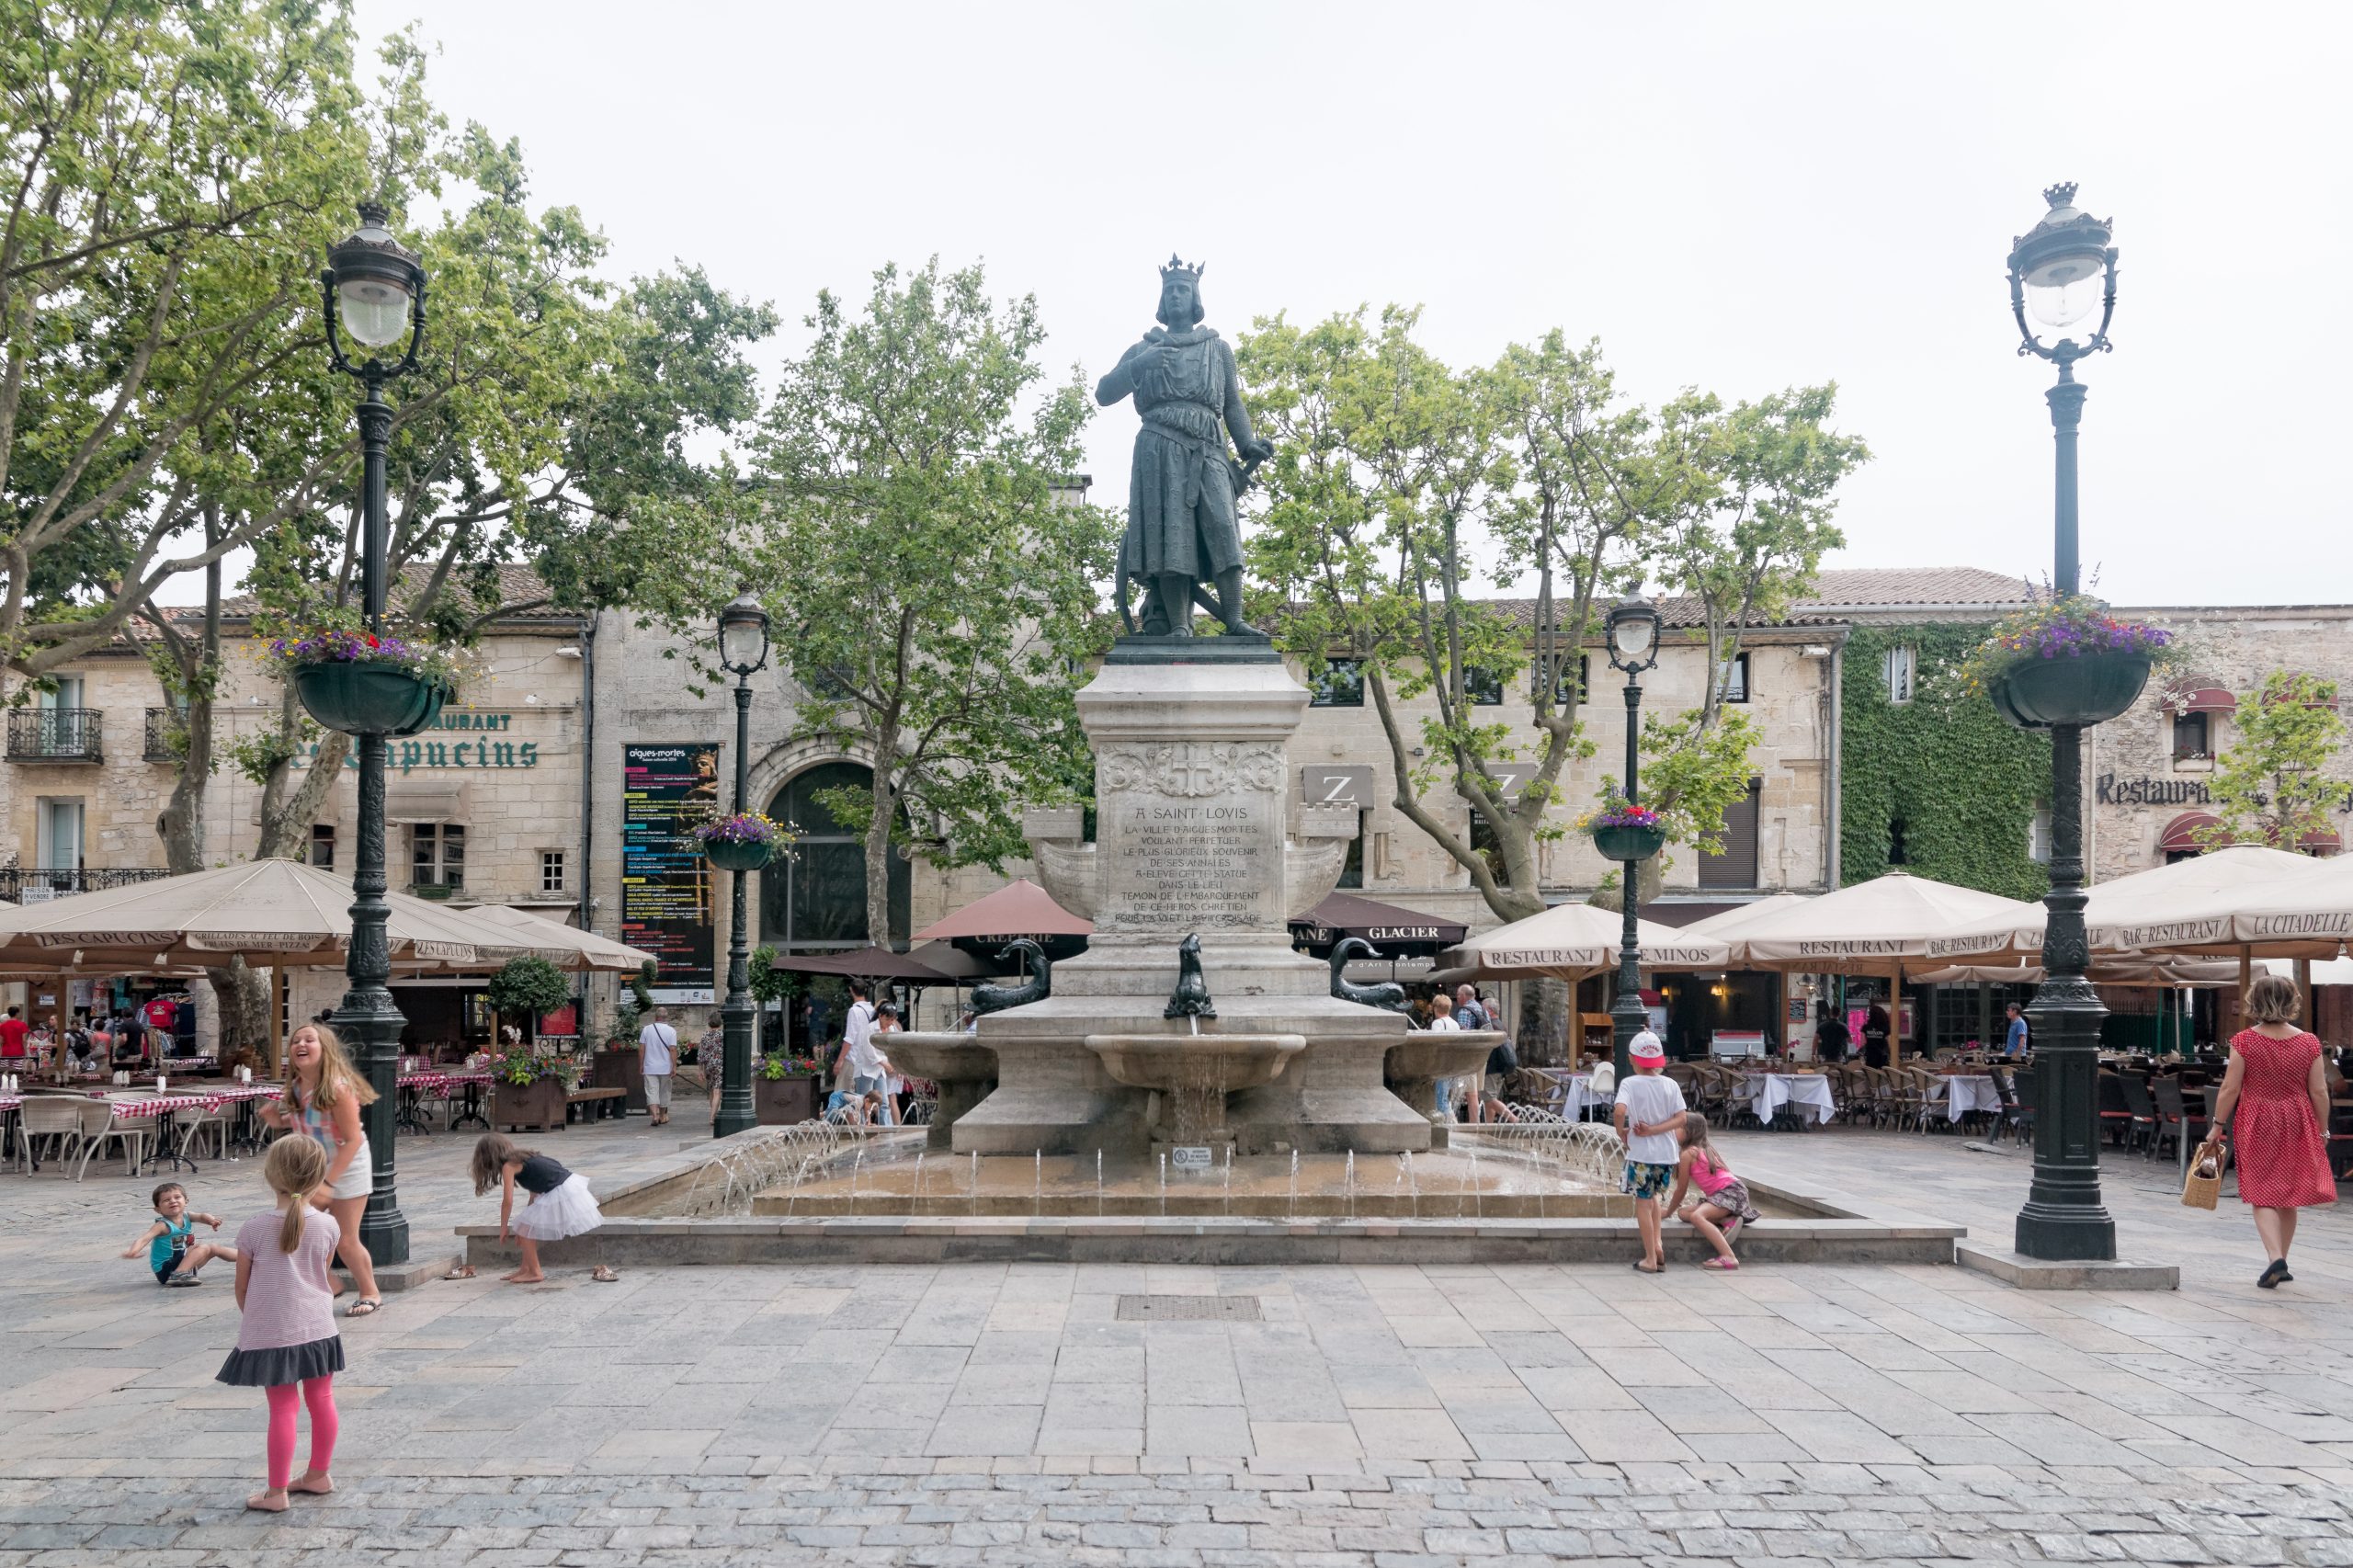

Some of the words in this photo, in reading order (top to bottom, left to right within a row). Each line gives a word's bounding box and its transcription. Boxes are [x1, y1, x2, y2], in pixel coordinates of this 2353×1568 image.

[429, 714, 512, 731] AURANT
[1323, 776, 1355, 801] Z
[1135, 807, 1145, 819] A
[1154, 807, 1198, 819] SAINT
[1206, 807, 1247, 820] LOVIS
[1125, 825, 1137, 835] LA
[1143, 825, 1169, 834] VILLE
[1141, 836, 1185, 845] VOULANT
[1123, 848, 1134, 857] LE
[1138, 848, 1160, 857] PLUS
[1164, 847, 1209, 857] GLORIEUX
[1212, 847, 1258, 857] SOUVENIR
[1150, 858, 1163, 868] DE
[1166, 858, 1185, 868] SES
[1187, 858, 1231, 868] ANNALES
[1178, 869, 1211, 879] CETTE
[1214, 869, 1247, 879] STATUE
[1158, 881, 1184, 890] DANS
[1188, 881, 1199, 890] LE
[1202, 881, 1222, 890] LIEU
[1160, 892, 1172, 901] DE
[1133, 903, 1145, 912] DE
[1150, 903, 1163, 912] CE
[1166, 903, 1197, 912] HEROS
[1115, 914, 1140, 923] POUR
[2254, 916, 2269, 935] LA
[2272, 913, 2352, 934] CITADELLE
[195, 932, 246, 940] GRILLADES
[1369, 926, 1438, 939] GLACIER
[2122, 920, 2222, 946] BAR-RESTAURANT
[40, 932, 75, 947] LES
[77, 932, 174, 945] CAPUCINS
[417, 940, 435, 955] LES
[437, 941, 472, 957] CAPUCINS
[1799, 939, 1908, 955] RESTAURANT
[1492, 949, 1597, 965] RESTAURANT
[1654, 948, 1711, 962] MINOS
